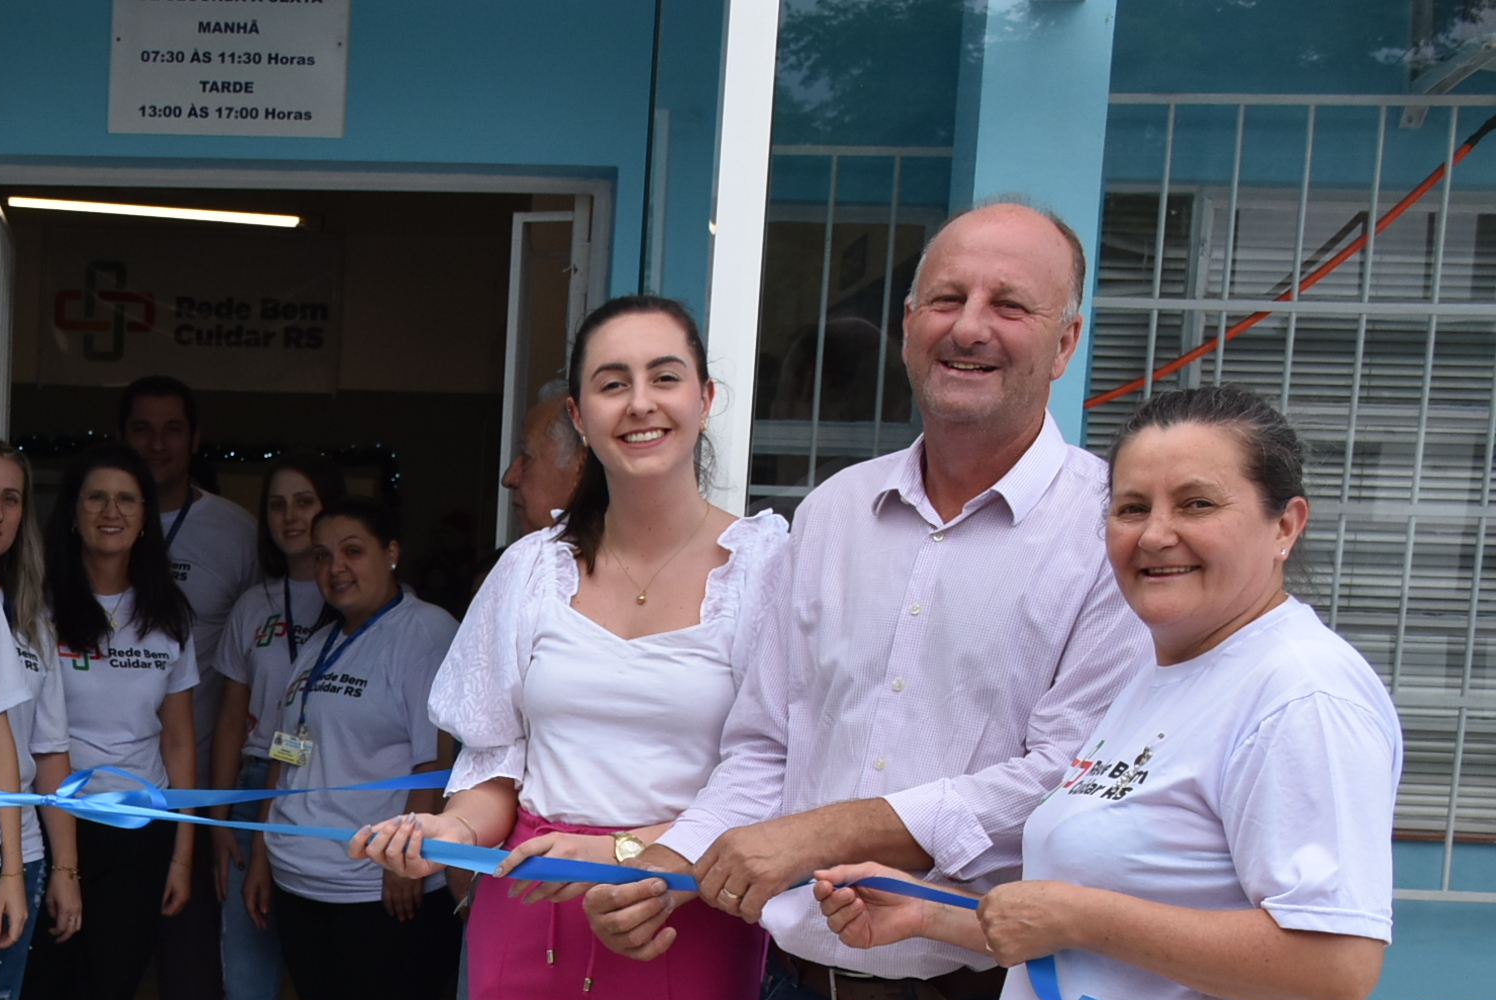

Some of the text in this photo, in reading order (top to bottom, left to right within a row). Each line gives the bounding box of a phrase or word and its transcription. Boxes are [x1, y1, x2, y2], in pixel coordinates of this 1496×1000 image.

[197, 20, 260, 35] MANHÃ
[140, 49, 316, 66] 07:30 ÀS 11:30 Horas
[199, 81, 254, 94] TARDE
[139, 104, 313, 121] 13:00 ÀS 17:00 Horas
[175, 297, 329, 321] Rede Bem
[174, 324, 325, 349] Cuidar RS
[171, 562, 191, 571] em
[108, 648, 170, 660] Rede Bem
[110, 658, 152, 669] Cuidar
[318, 671, 369, 688] ede Bem
[344, 686, 363, 698] RS
[1108, 761, 1149, 785] Bm
